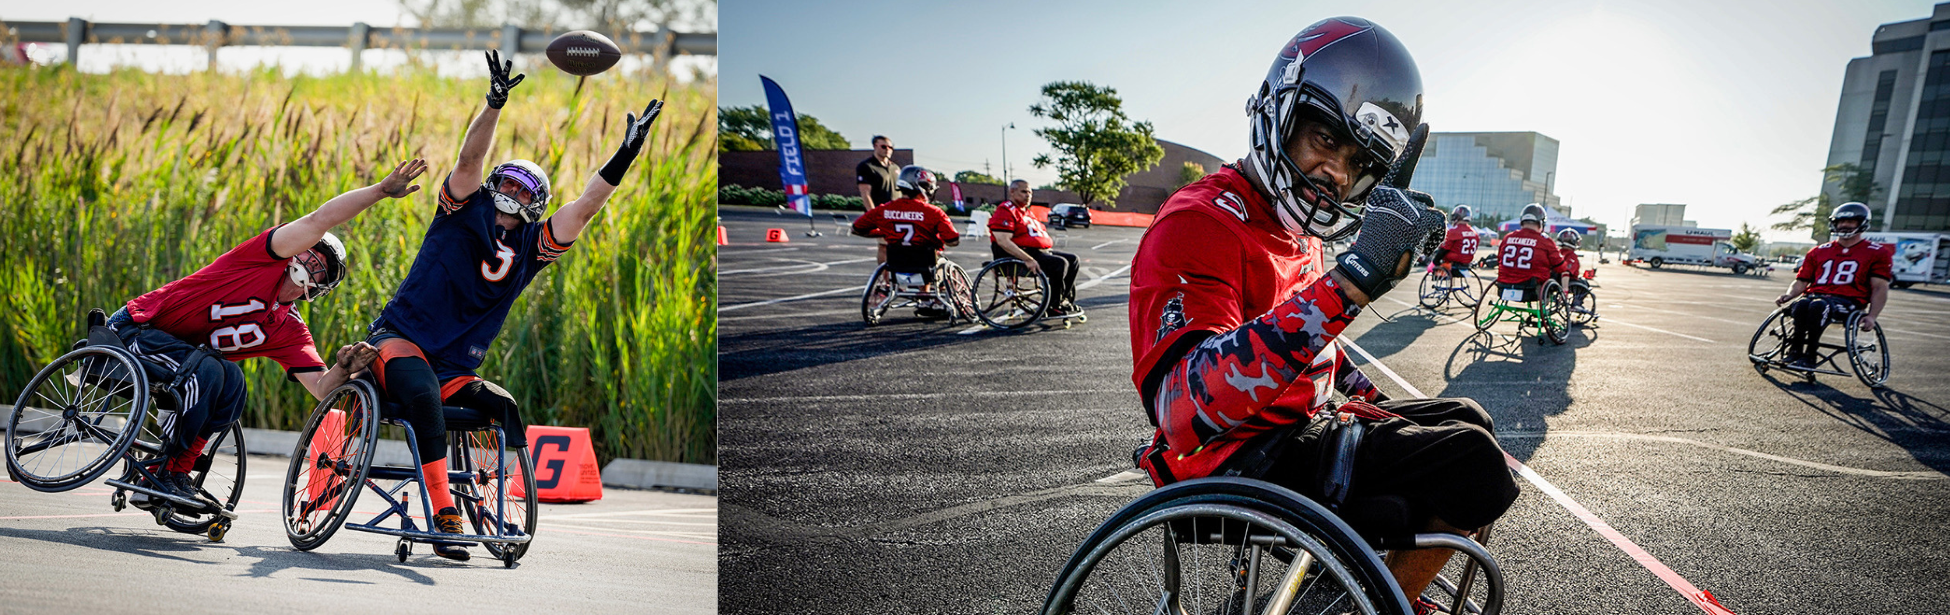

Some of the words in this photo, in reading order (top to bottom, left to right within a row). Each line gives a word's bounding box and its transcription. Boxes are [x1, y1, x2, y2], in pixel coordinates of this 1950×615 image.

[775, 110, 791, 122] 1
[778, 125, 802, 176] FIELD
[883, 209, 924, 221] BUCCANEERS
[769, 230, 780, 241] G
[895, 223, 915, 246] 7
[1506, 237, 1538, 247] BUCCANEERS
[1461, 238, 1477, 255] 23
[1502, 245, 1534, 269] 22
[481, 239, 516, 282] 3
[1816, 259, 1859, 286] 18
[209, 298, 267, 352] 18
[532, 435, 571, 489] G
